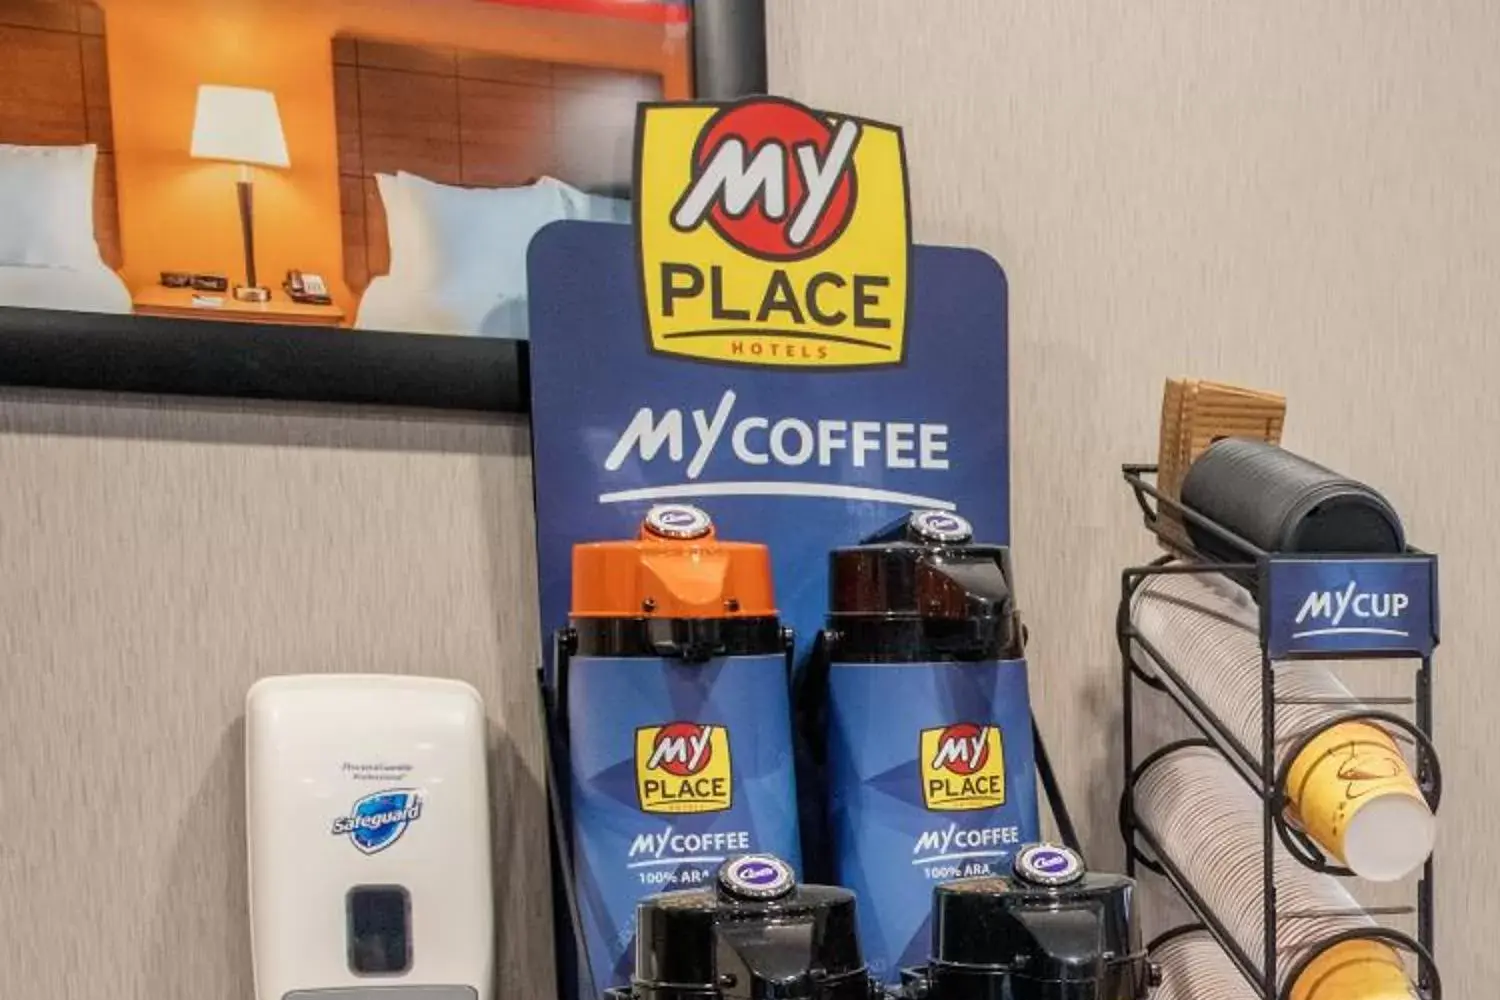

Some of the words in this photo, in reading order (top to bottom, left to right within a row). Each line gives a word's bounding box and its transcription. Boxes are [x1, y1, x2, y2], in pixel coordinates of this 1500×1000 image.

[660, 261, 892, 330] PLACE
[731, 341, 829, 360] HOTELS
[643, 777, 727, 799] PLACE
[929, 775, 1001, 797] PLACE
[640, 871, 678, 884] 100%
[924, 865, 961, 879] 100%
